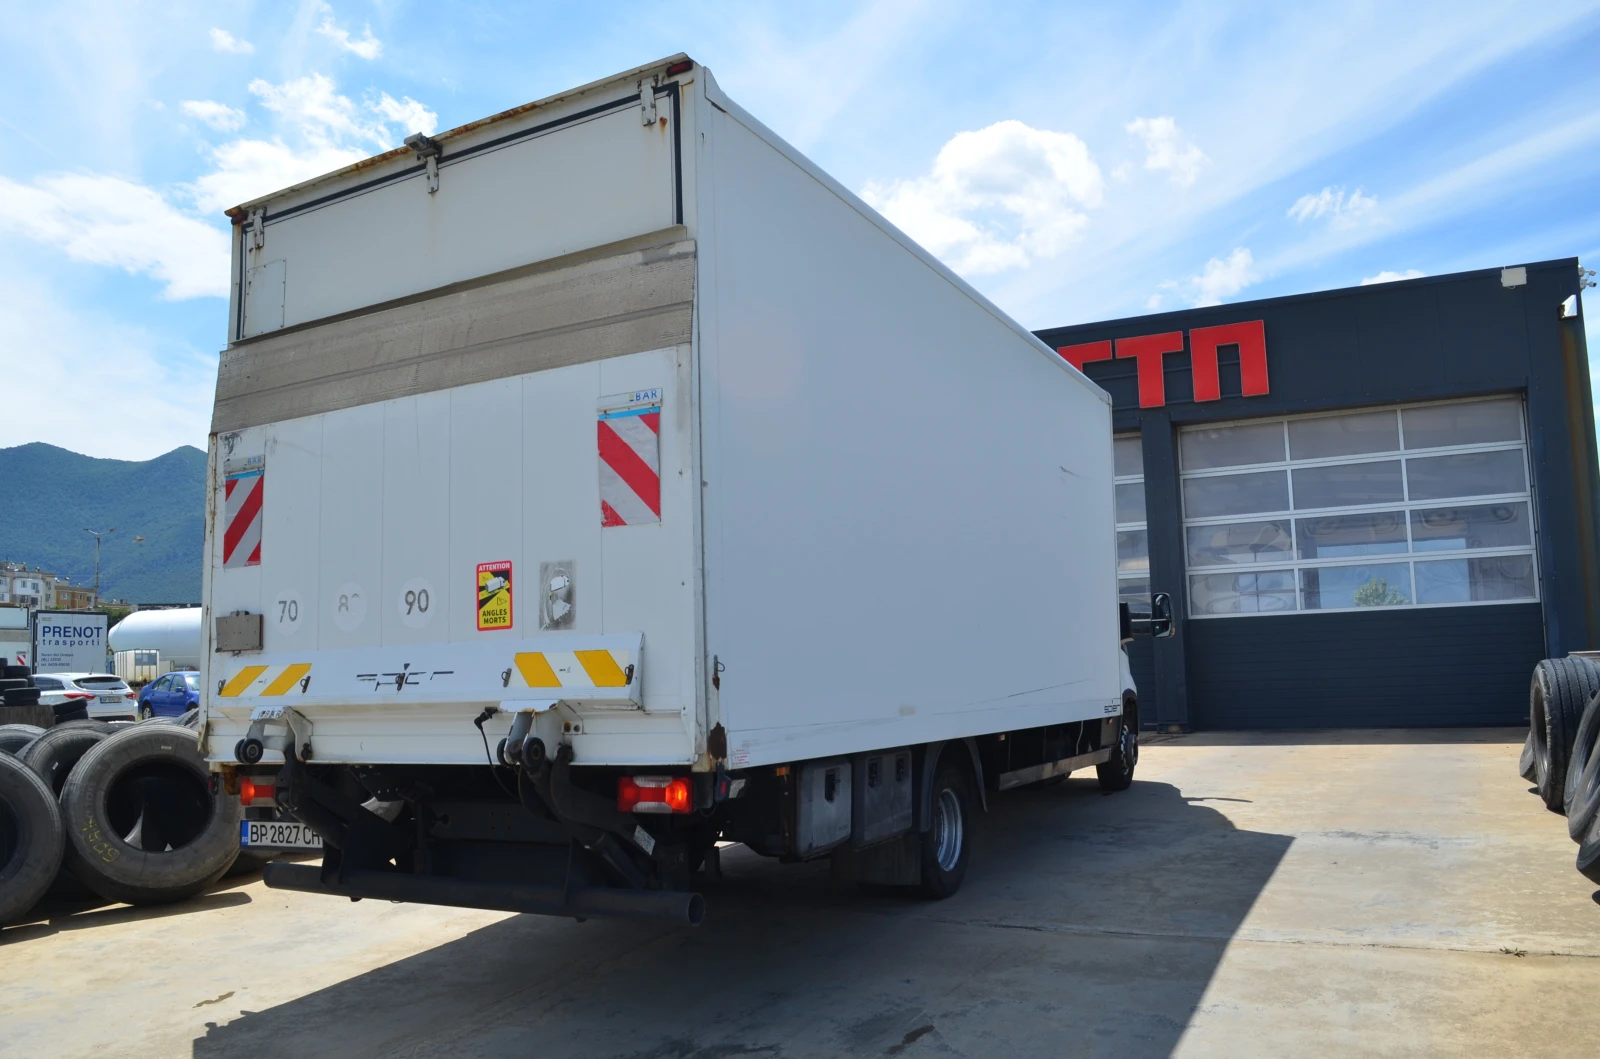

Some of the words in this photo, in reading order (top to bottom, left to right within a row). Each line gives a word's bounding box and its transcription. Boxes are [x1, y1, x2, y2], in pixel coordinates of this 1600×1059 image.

[478, 562, 511, 571] ATTENTION
[338, 593, 361, 613] 8
[404, 588, 430, 616] 90
[277, 599, 298, 623] 70
[482, 608, 508, 617] ANGLES
[483, 616, 507, 624] MORTS
[42, 626, 103, 638] PRENOT
[42, 639, 100, 647] trasporti
[250, 824, 268, 843] BP
[270, 824, 300, 844] 2827
